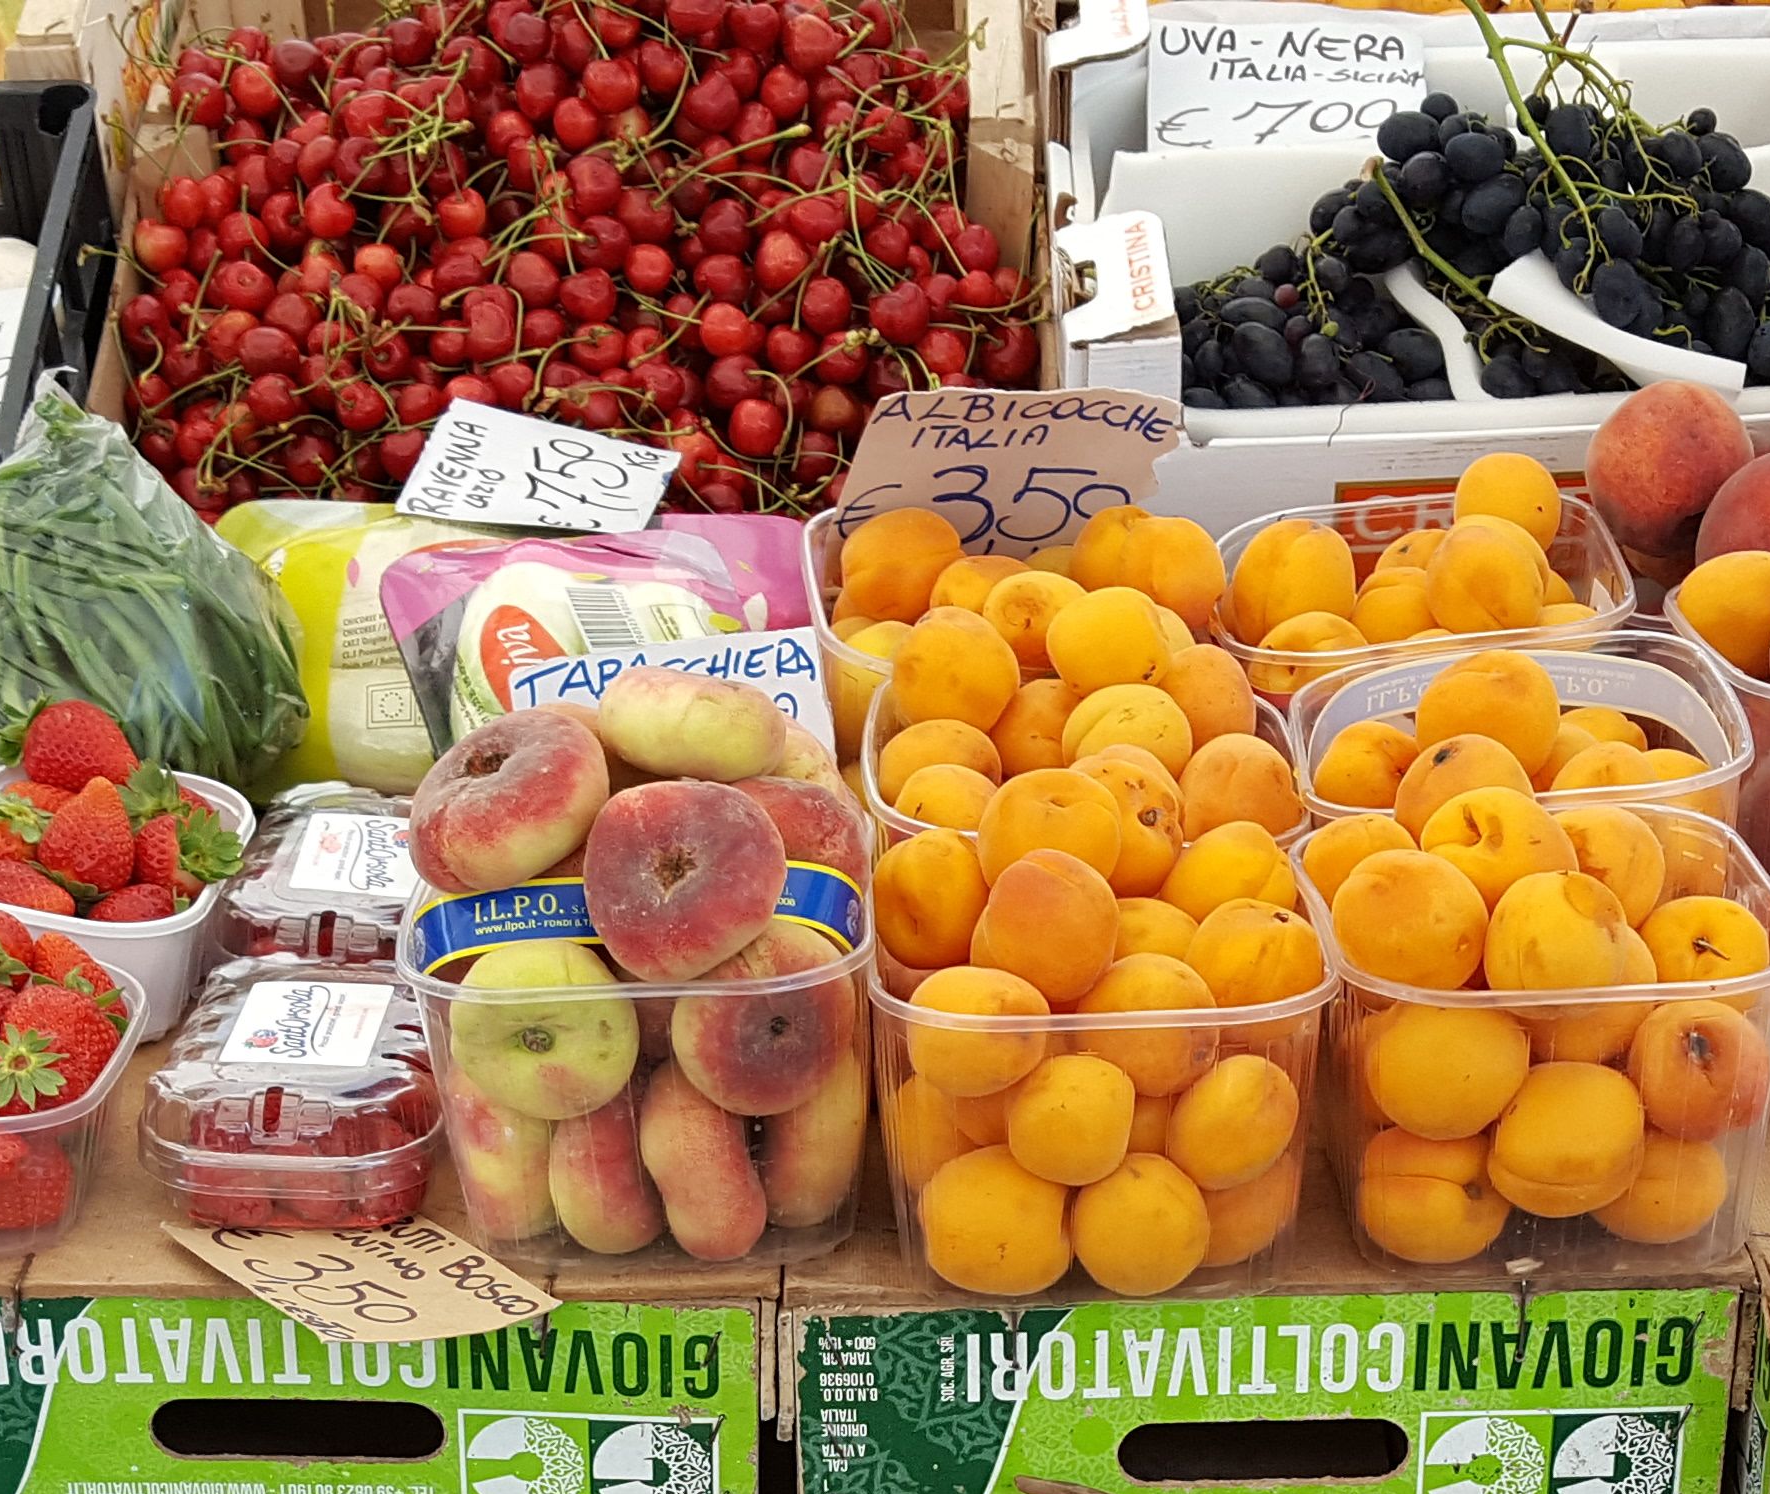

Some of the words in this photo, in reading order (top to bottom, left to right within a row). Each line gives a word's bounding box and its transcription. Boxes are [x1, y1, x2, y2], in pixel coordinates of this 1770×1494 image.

[1159, 26, 1237, 55] UVA
[1277, 27, 1405, 62] NERA
[1155, 106, 1213, 150] €
[1124, 219, 1157, 314] CRISTINA
[871, 392, 1175, 443] ALBICOCCHE
[911, 424, 1051, 452] ITALIA
[405, 419, 490, 517] RAVENNA
[474, 893, 565, 924] I.L.P.O.
[439, 1254, 540, 1316] BOSCO
[841, 1351, 872, 1366] TARA
[820, 1408, 857, 1423] ITALIA
